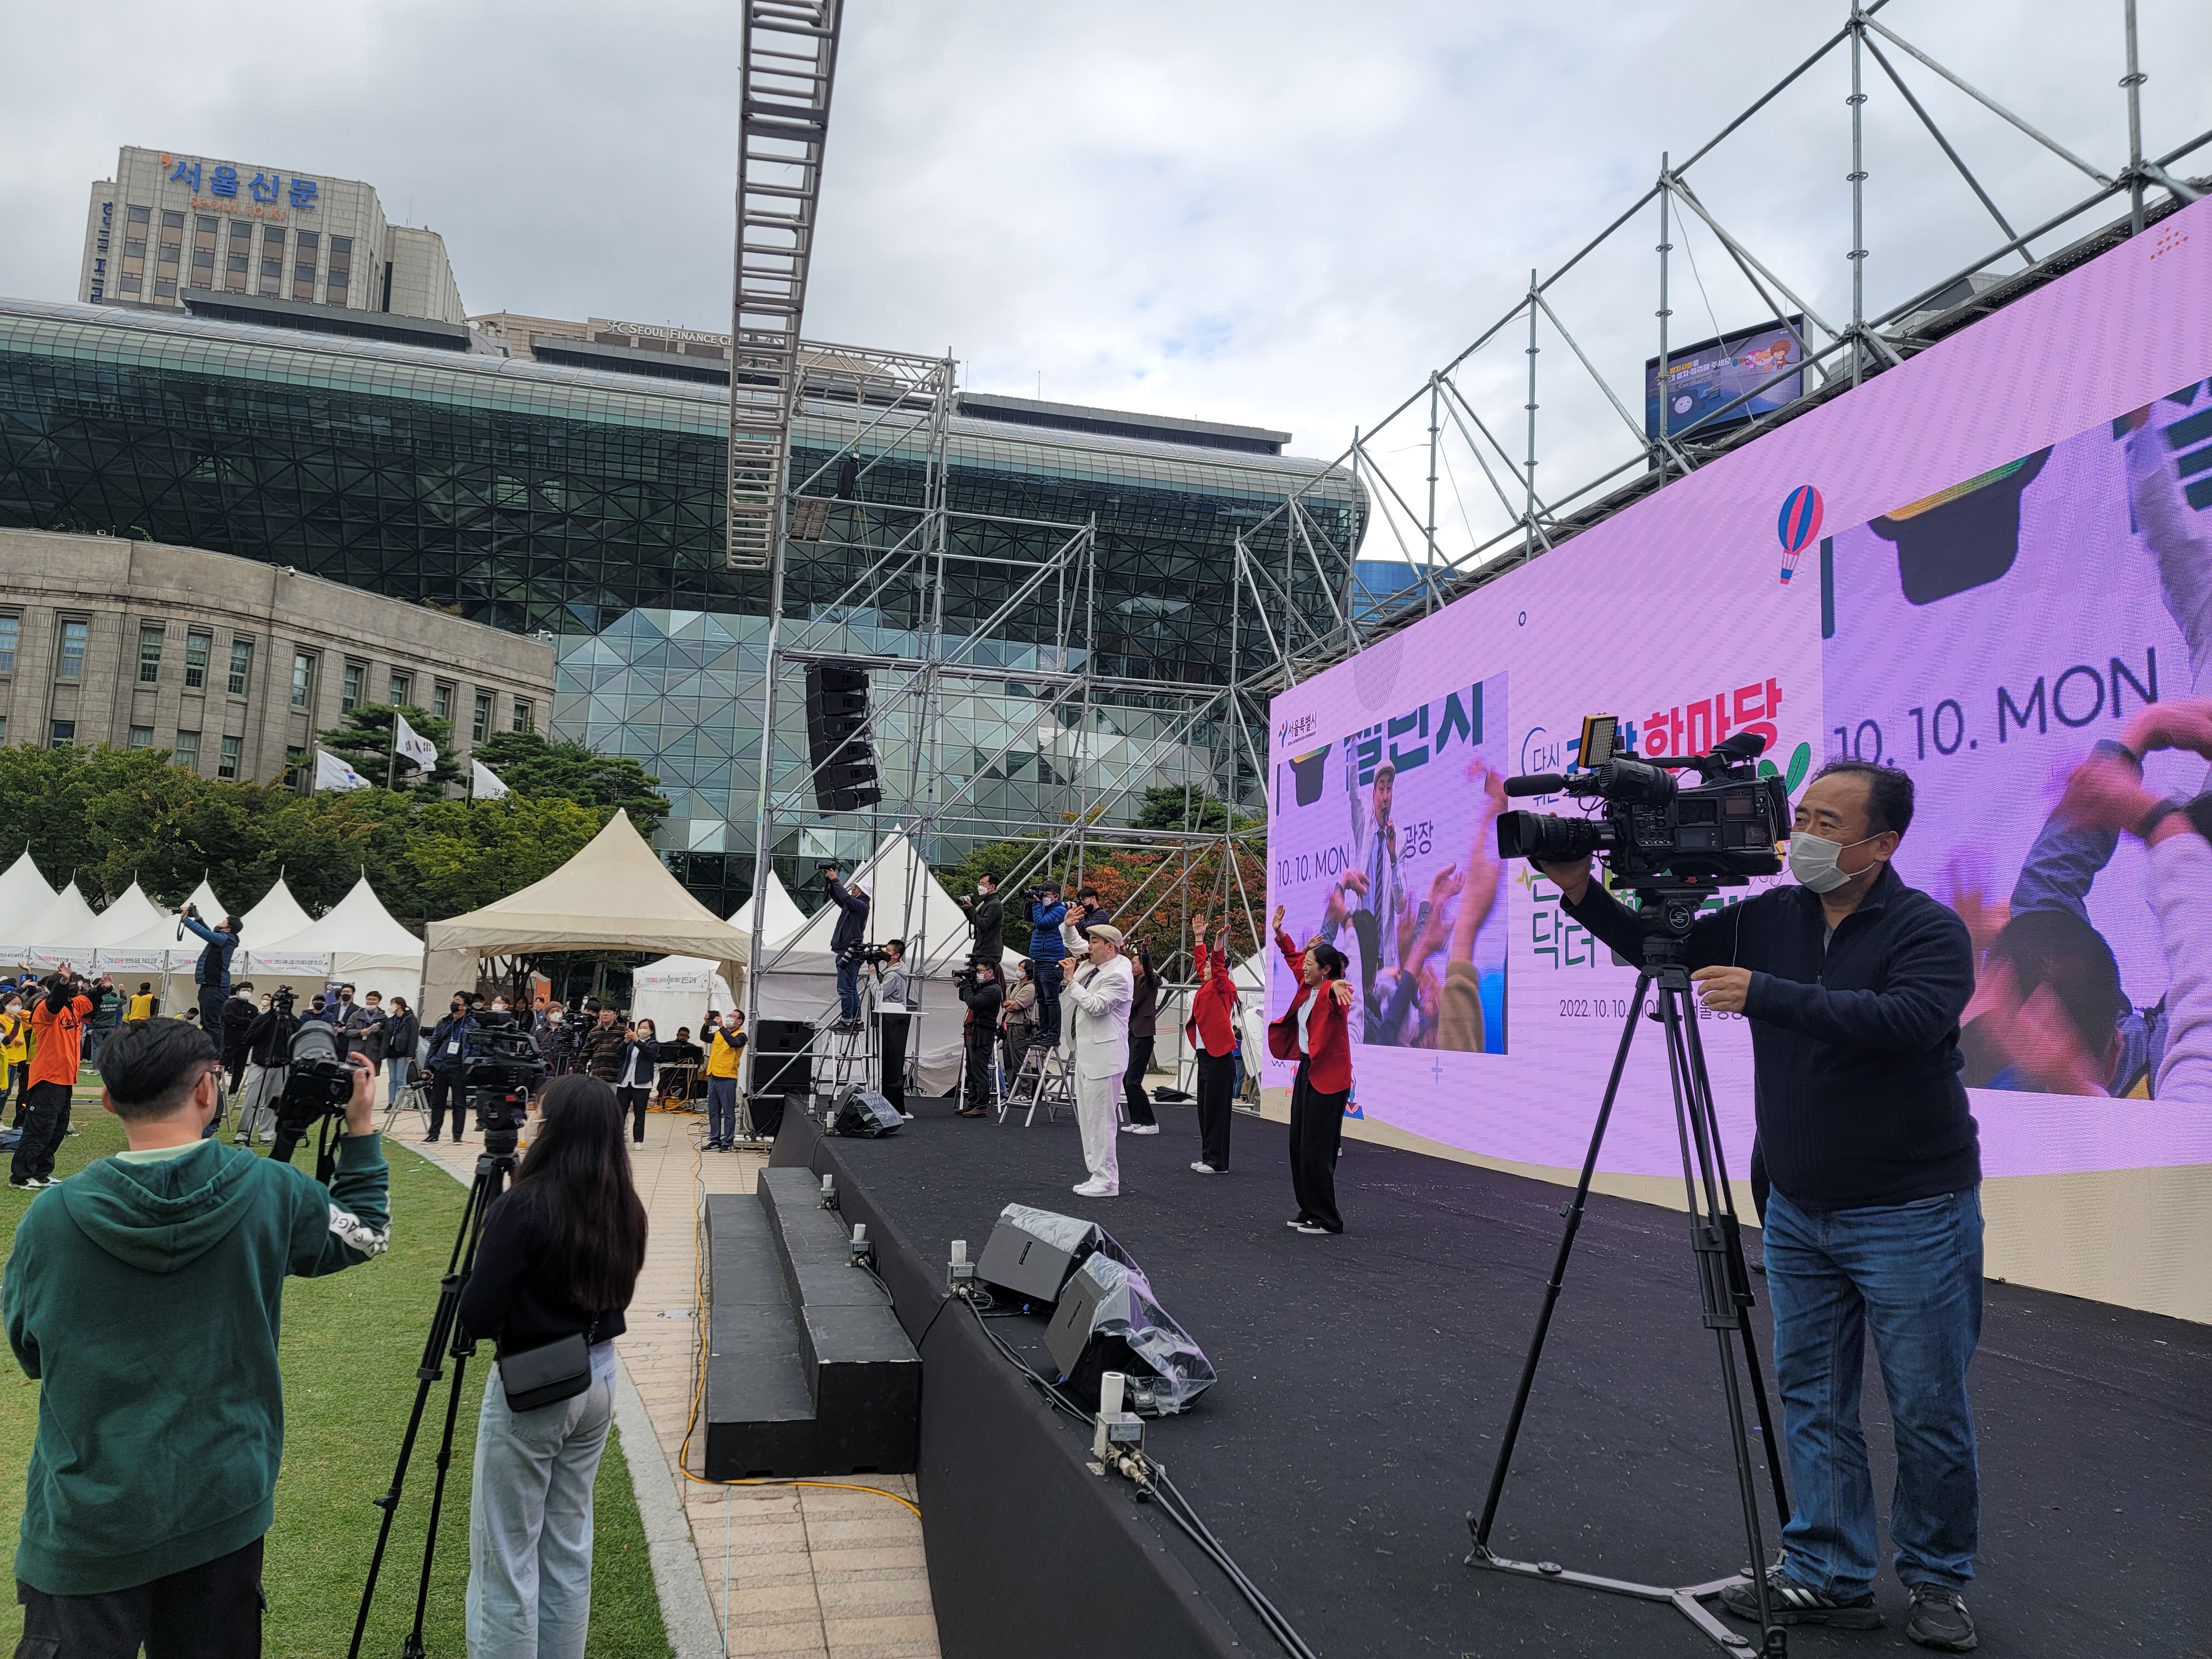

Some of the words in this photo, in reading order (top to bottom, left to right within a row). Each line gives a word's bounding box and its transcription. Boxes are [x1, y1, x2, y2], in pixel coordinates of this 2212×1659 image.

[170, 161, 319, 209] 서울신문
[190, 196, 287, 220] seoul.co.kr
[629, 324, 666, 338] SEOUL
[669, 328, 717, 344] FINANCE
[1997, 646, 2159, 744] MON
[1288, 710, 1317, 738] 서울특별시
[1533, 742, 1559, 774] 다시
[1404, 820, 1434, 859] 광장
[1316, 843, 1350, 879] MON
